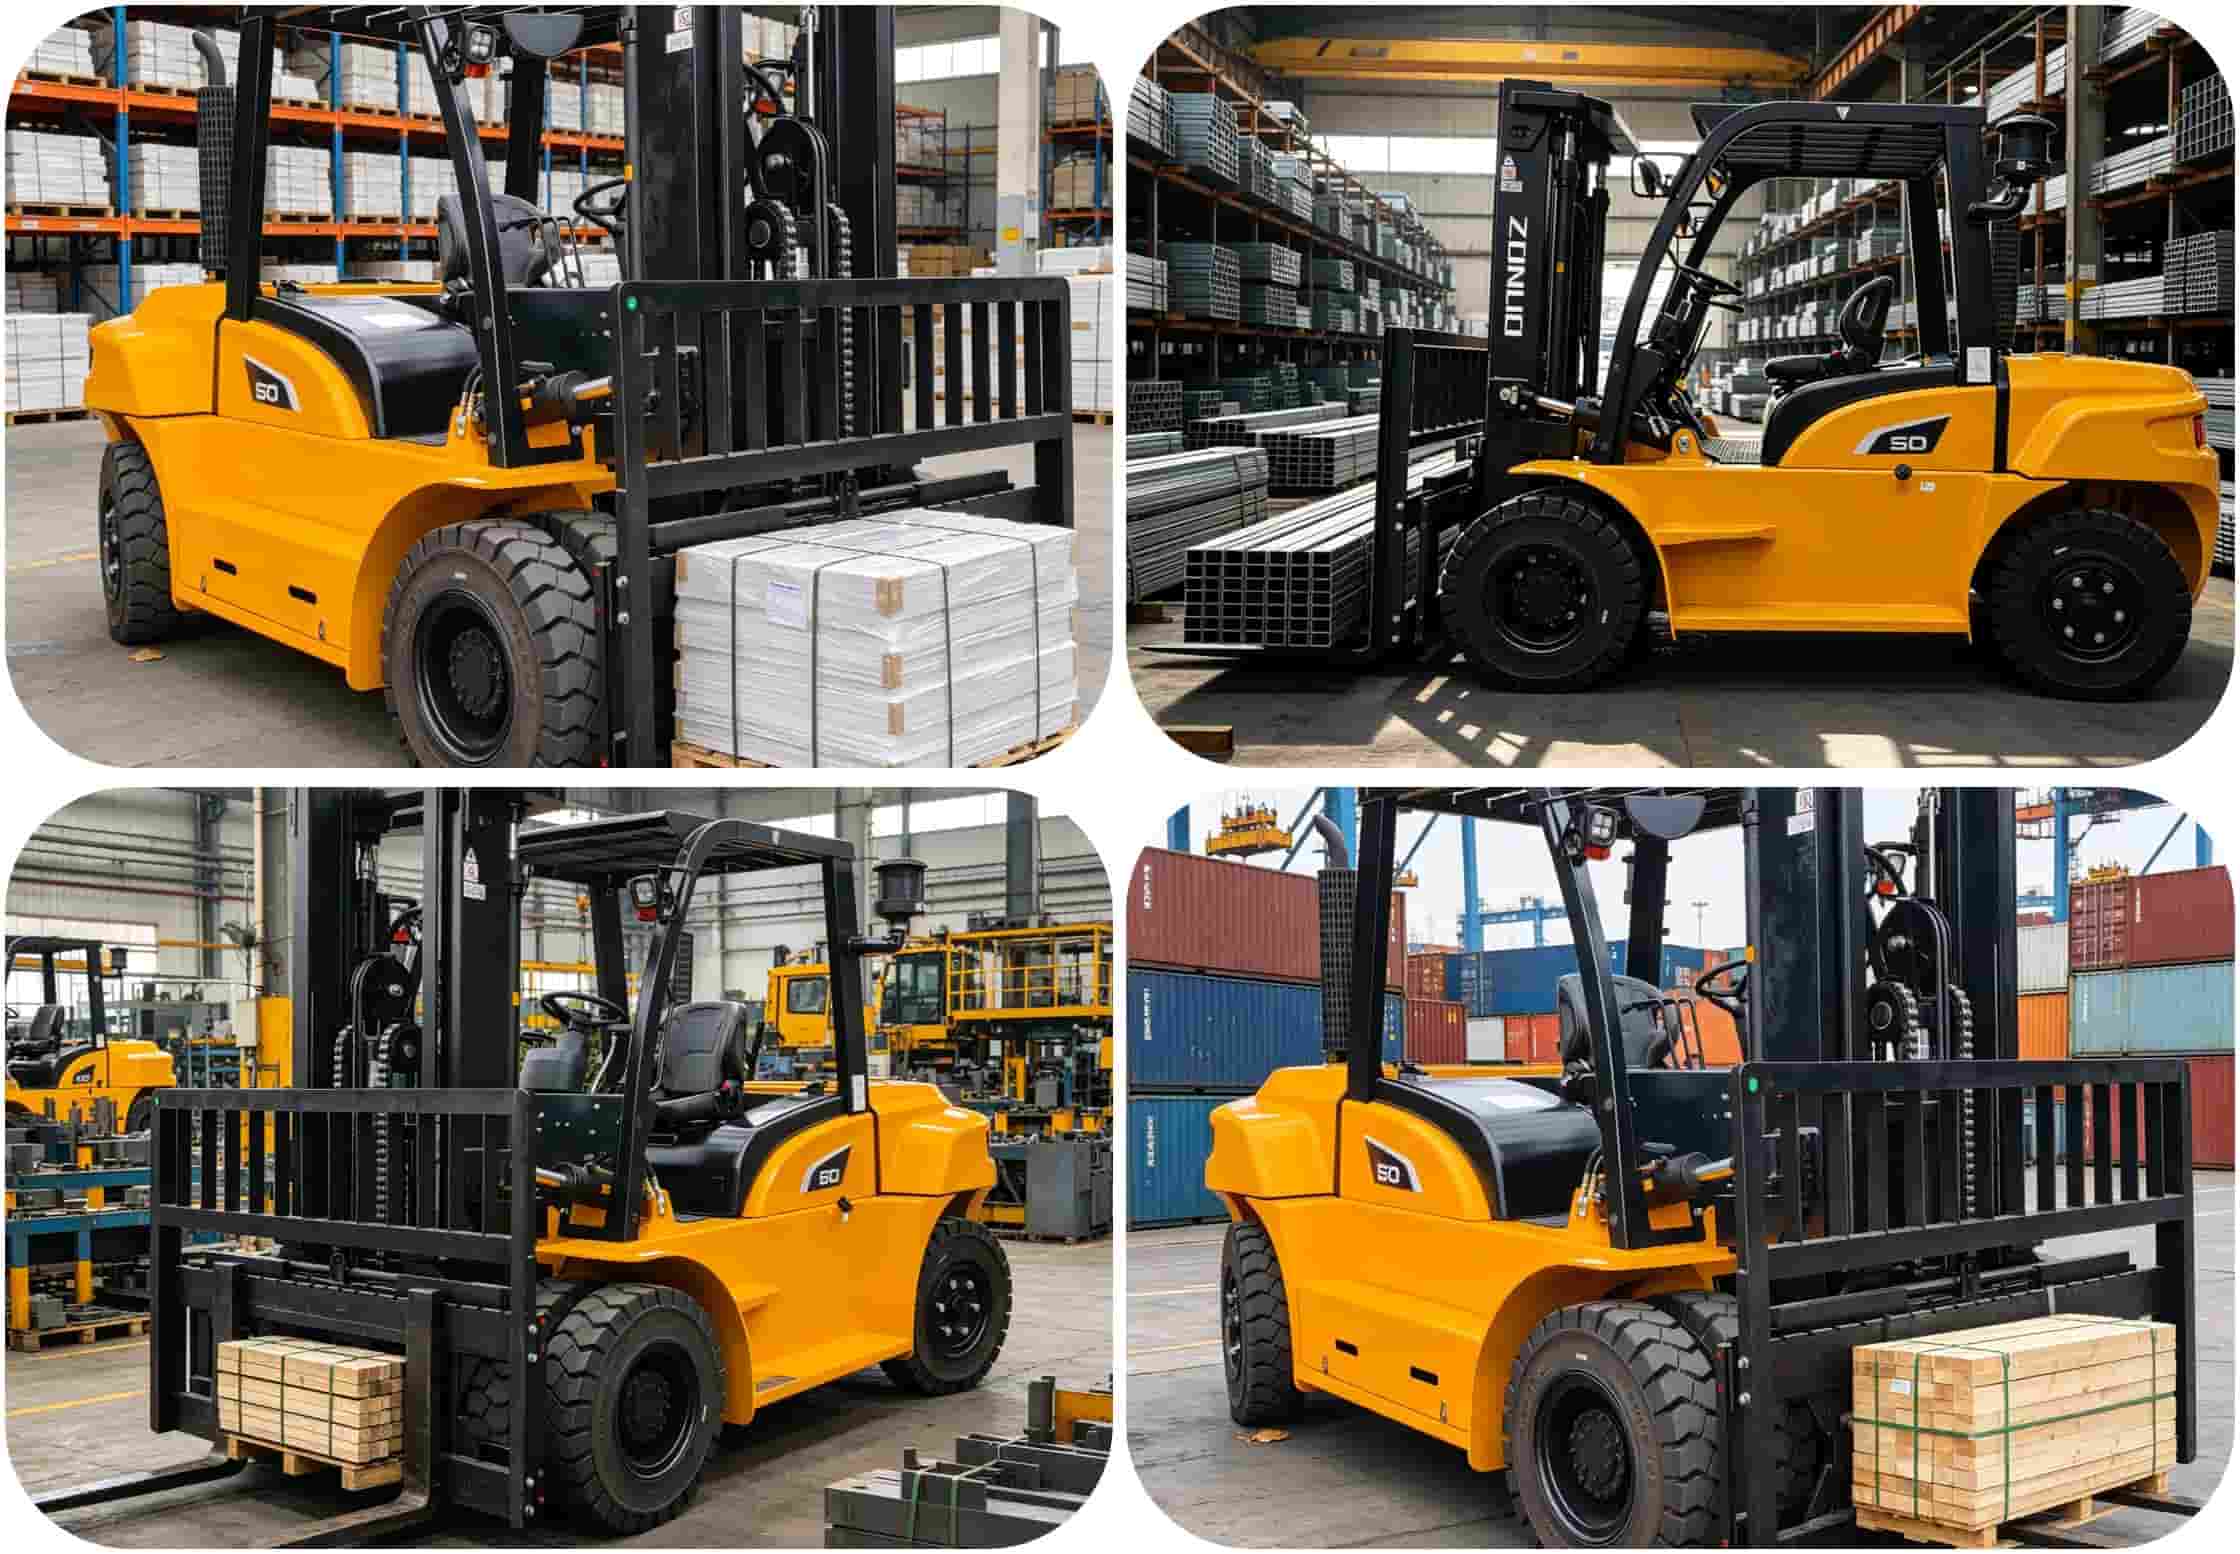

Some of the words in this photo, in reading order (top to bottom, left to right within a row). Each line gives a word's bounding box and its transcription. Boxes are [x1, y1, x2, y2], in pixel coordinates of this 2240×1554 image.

[255, 382, 279, 402] 50
[1890, 436, 1927, 451] 50
[1376, 1163, 1401, 1184] 50
